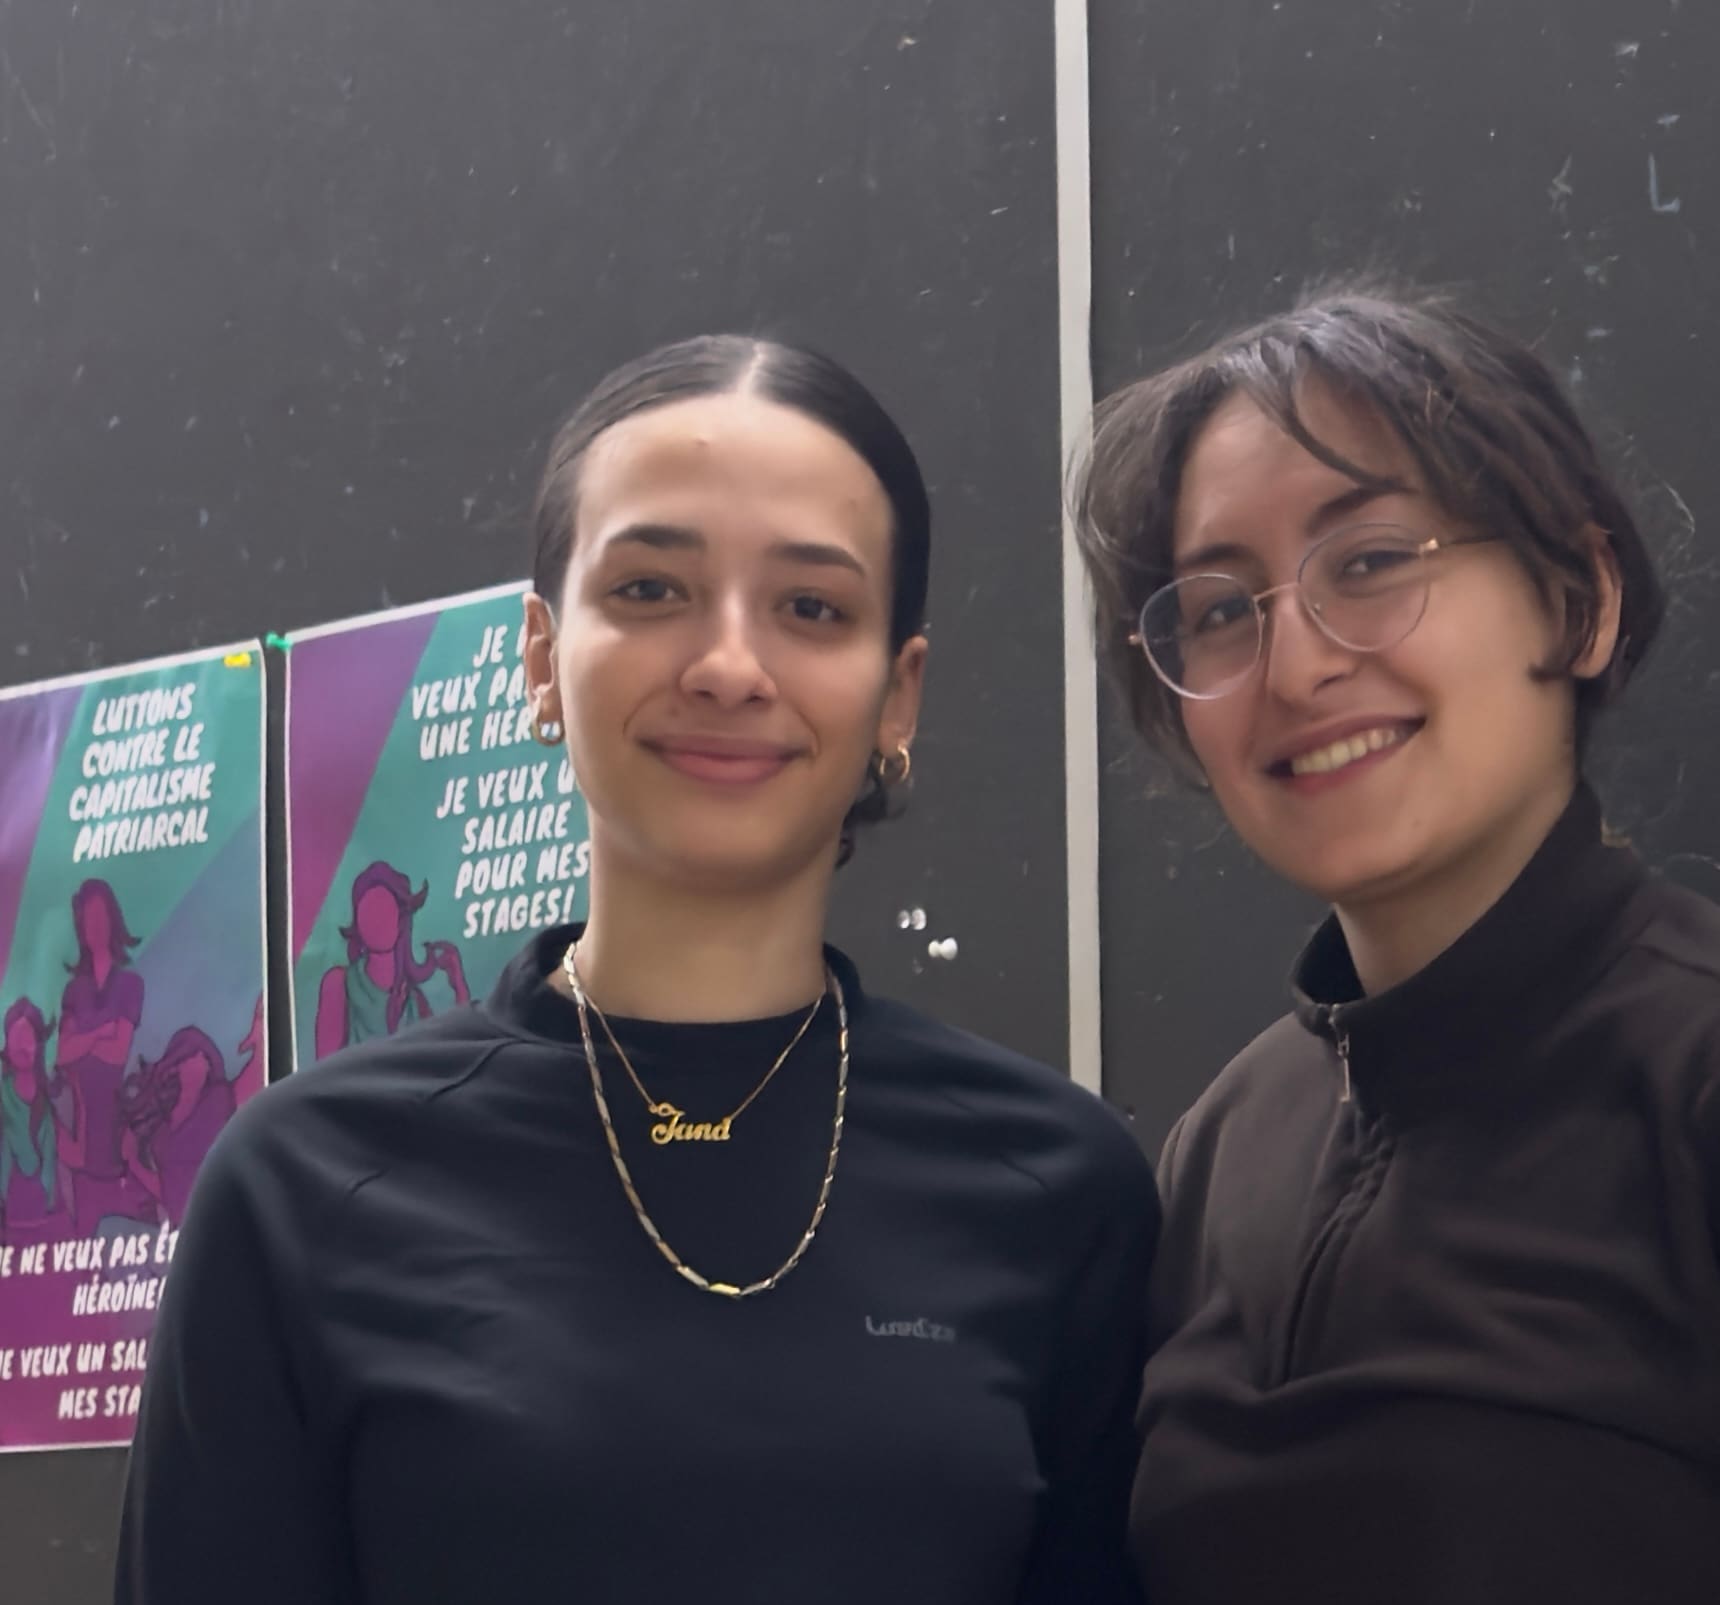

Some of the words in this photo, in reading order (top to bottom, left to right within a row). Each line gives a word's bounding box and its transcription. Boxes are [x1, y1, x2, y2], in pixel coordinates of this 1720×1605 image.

[473, 624, 508, 668] JE
[93, 683, 196, 736] LUTTONS
[412, 671, 482, 720] VEUX
[488, 663, 529, 707] PA
[82, 733, 167, 778] CONTRE
[174, 722, 205, 763] LE
[420, 717, 473, 761] UNE
[68, 762, 215, 822] CAPITALISME
[436, 776, 469, 819] JE
[478, 761, 549, 809] VEUX
[557, 758, 577, 794] U
[73, 808, 208, 863] PATRIARCAL
[461, 800, 572, 855] SALAIRE
[455, 850, 528, 900] POUR
[536, 841, 591, 884] MES
[463, 884, 576, 938] STAGES!
[19, 1243, 48, 1275] NE
[53, 1237, 105, 1272] VEUX
[109, 1233, 151, 1268] PAS
[154, 1218, 180, 1264] ÊT
[21, 1343, 72, 1378] VEUX
[76, 1343, 106, 1373] UN
[58, 1386, 99, 1419] MES
[104, 1384, 142, 1417] STA
